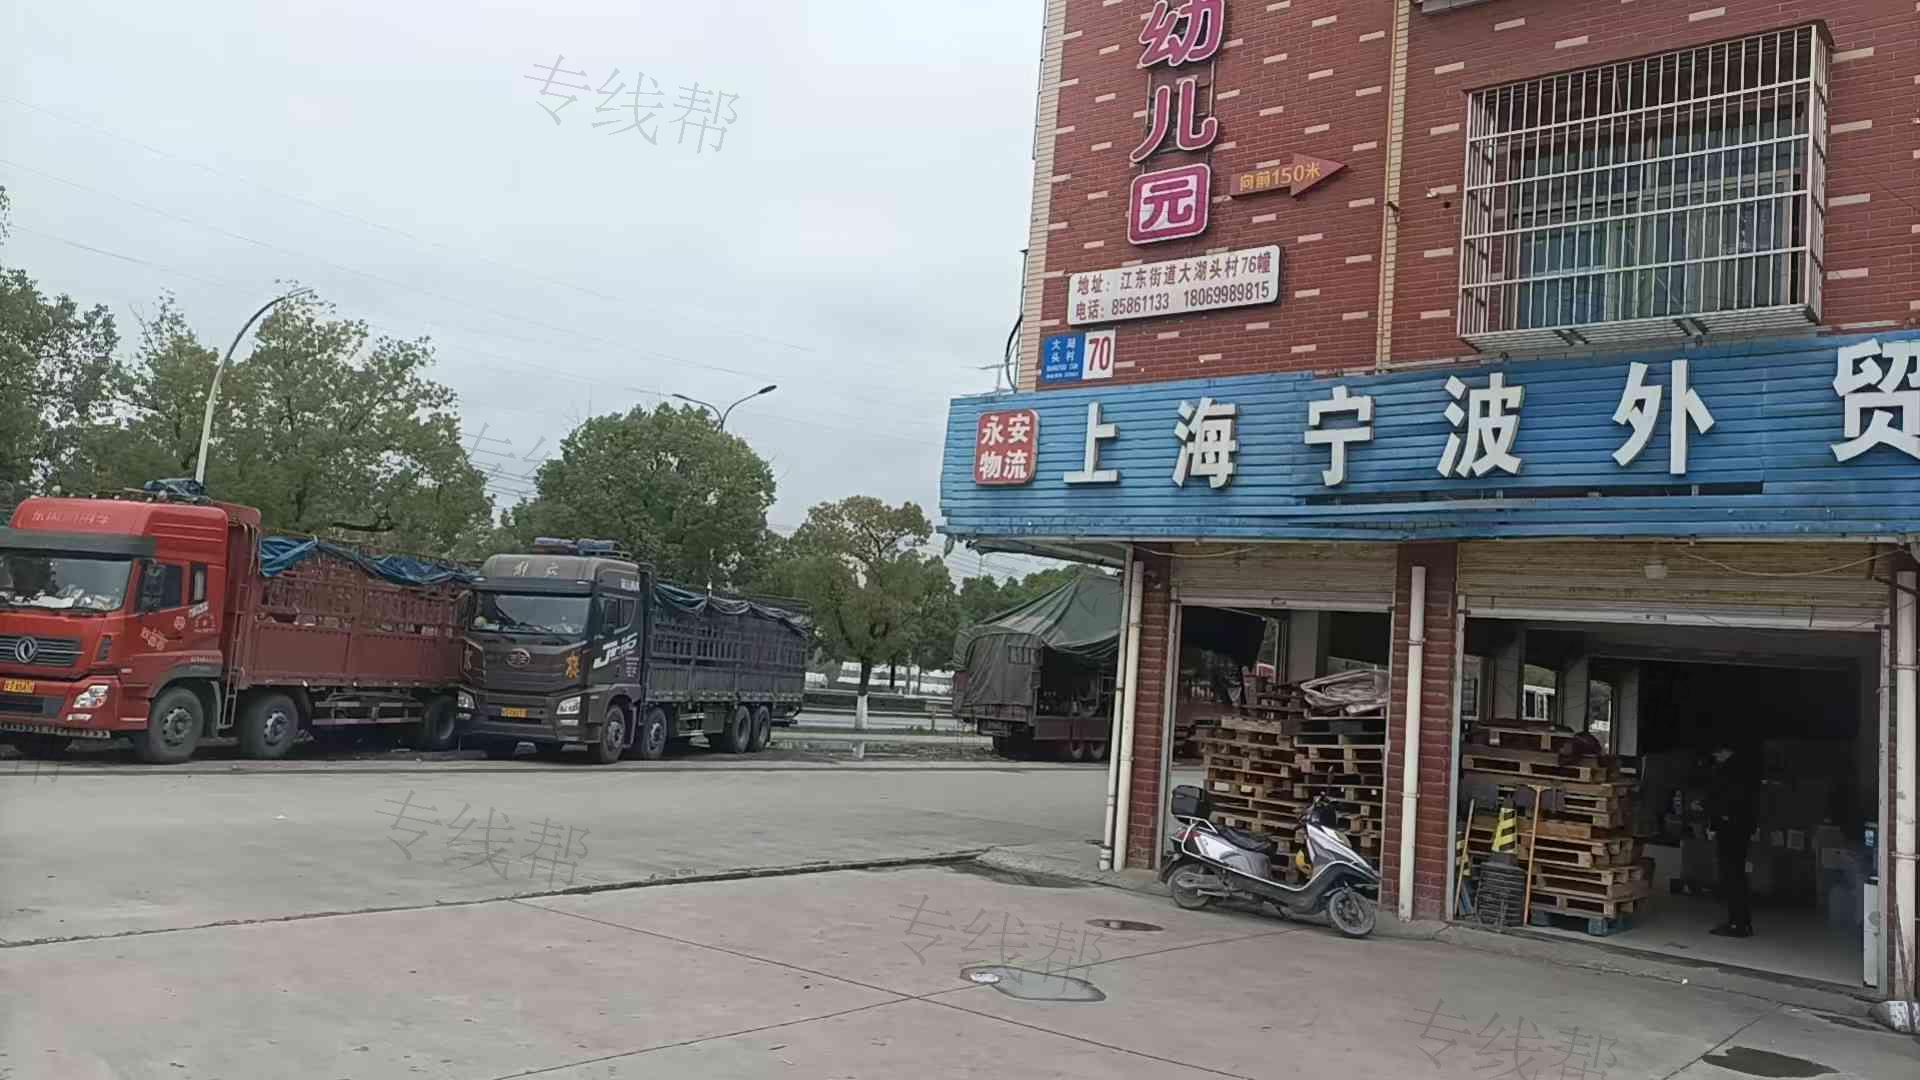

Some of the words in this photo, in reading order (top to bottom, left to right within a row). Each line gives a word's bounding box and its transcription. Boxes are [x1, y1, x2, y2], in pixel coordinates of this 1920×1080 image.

[1129, 0, 1225, 244] 幼儿园
[1240, 162, 1321, 192] 向前150米
[1111, 292, 1170, 316] 85861133
[1183, 281, 1270, 307] 18069989815
[1089, 336, 1112, 371] 70
[980, 414, 1031, 445] 永安
[979, 451, 1029, 479] 物流
